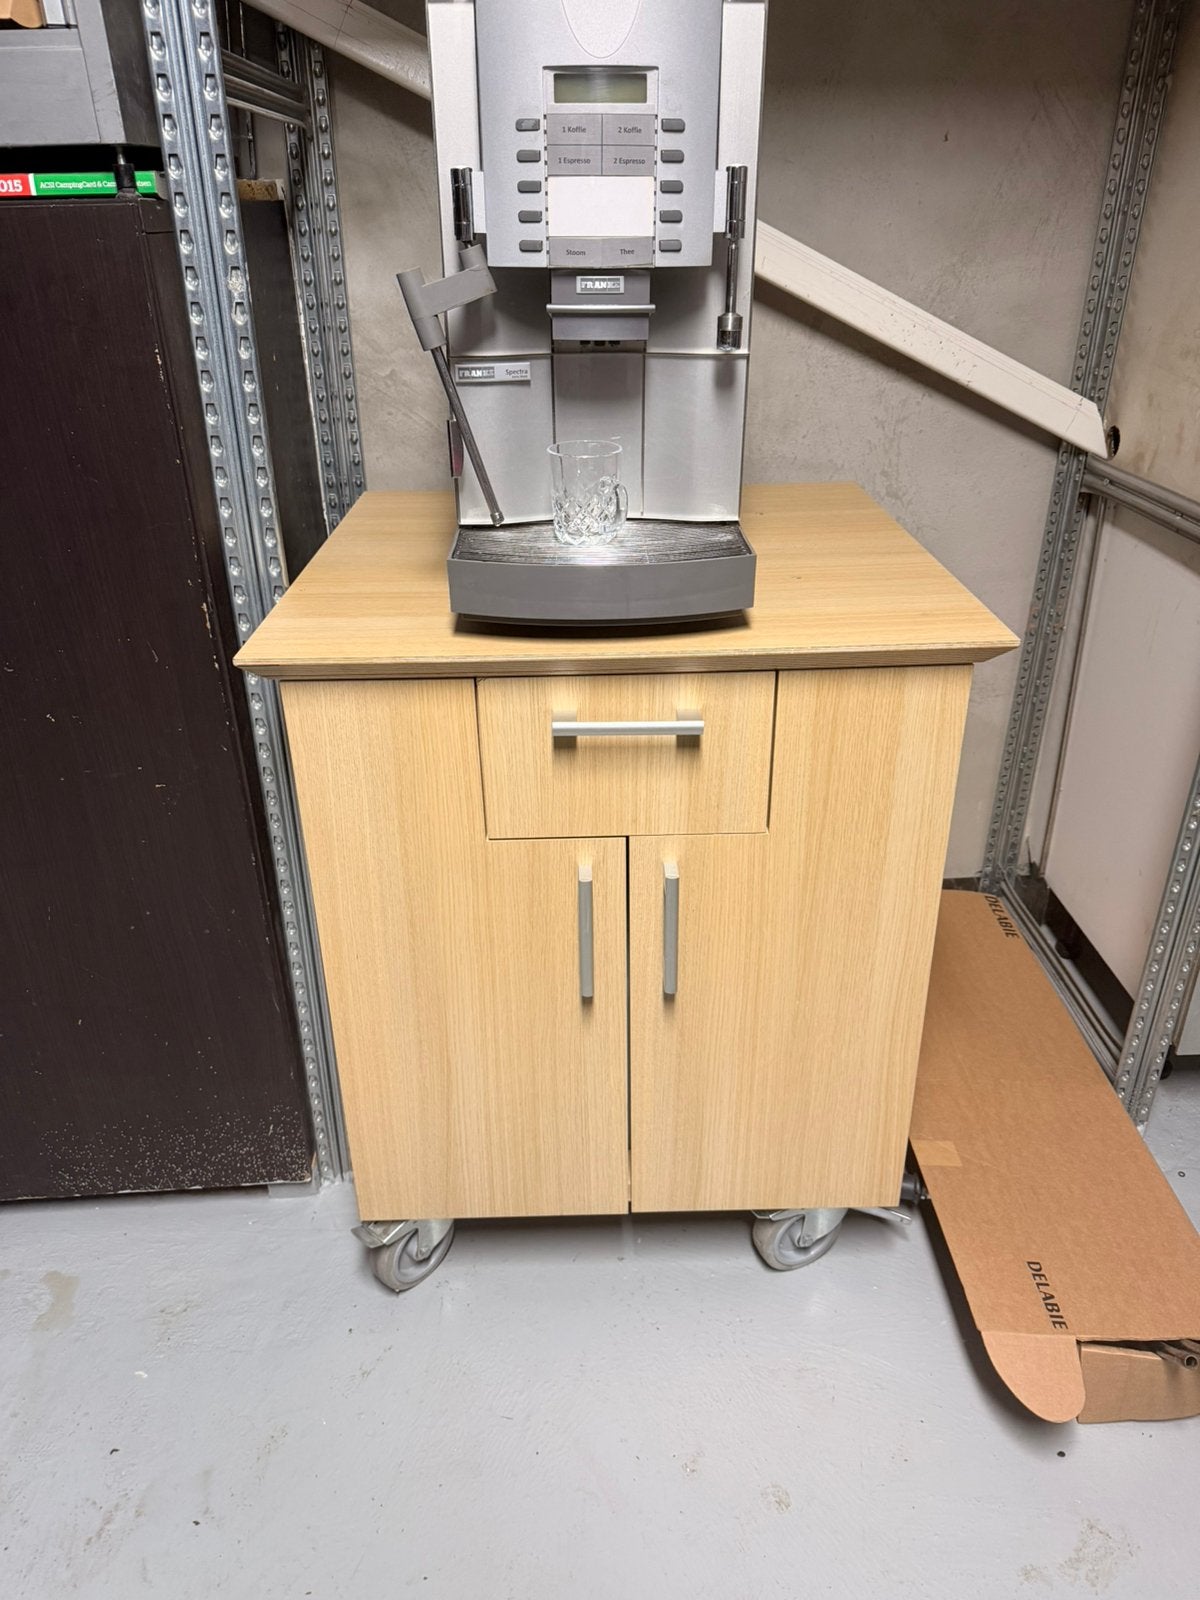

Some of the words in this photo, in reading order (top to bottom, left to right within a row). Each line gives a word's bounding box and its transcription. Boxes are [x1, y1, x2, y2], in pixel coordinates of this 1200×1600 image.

[563, 157, 591, 165] Espresso
[618, 157, 646, 165] Espresso
[984, 895, 1020, 938] DELABIE
[1026, 1261, 1069, 1330] DELABIE
